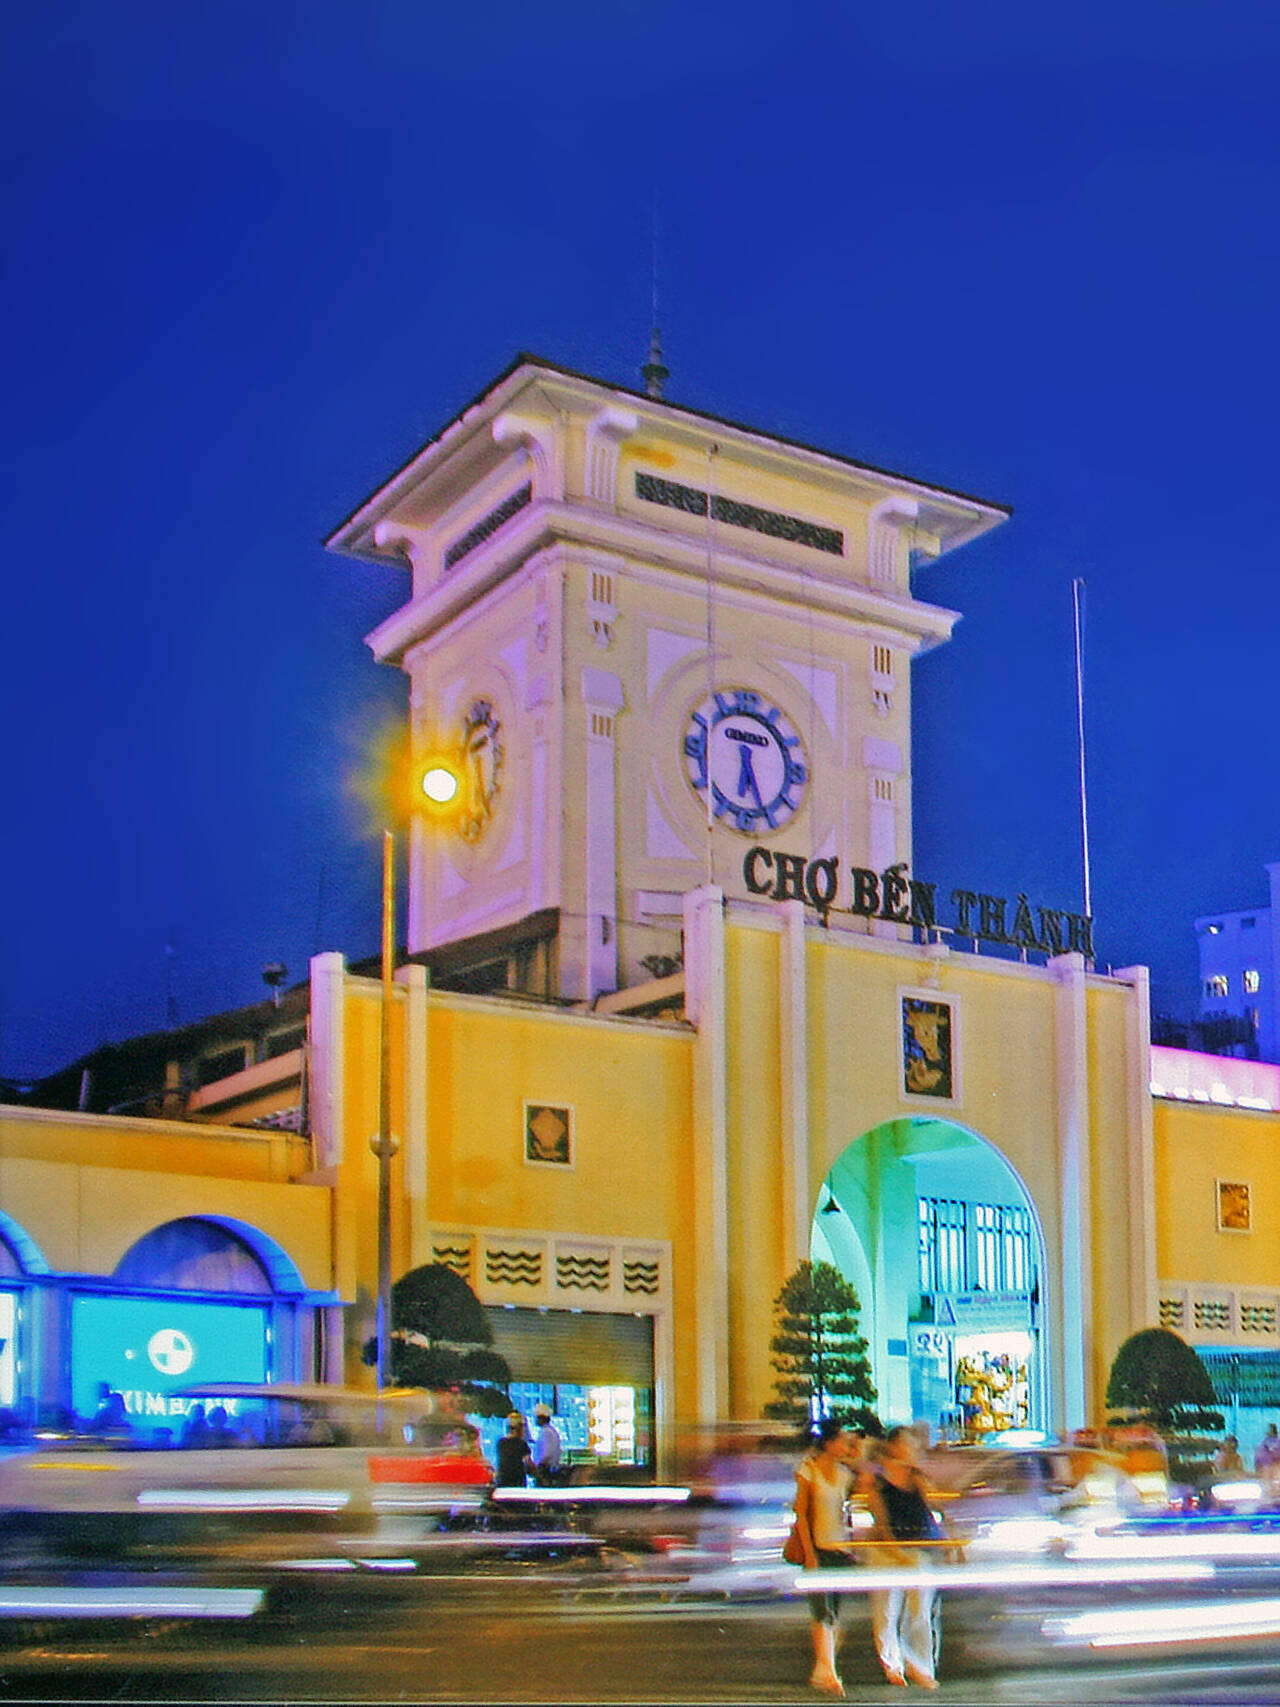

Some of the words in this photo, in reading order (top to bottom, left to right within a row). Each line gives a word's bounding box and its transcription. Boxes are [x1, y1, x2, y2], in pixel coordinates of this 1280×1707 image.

[743, 846, 839, 914] CHỢ
[851, 862, 937, 926] BẾN
[951, 891, 1096, 960] THÀNH
